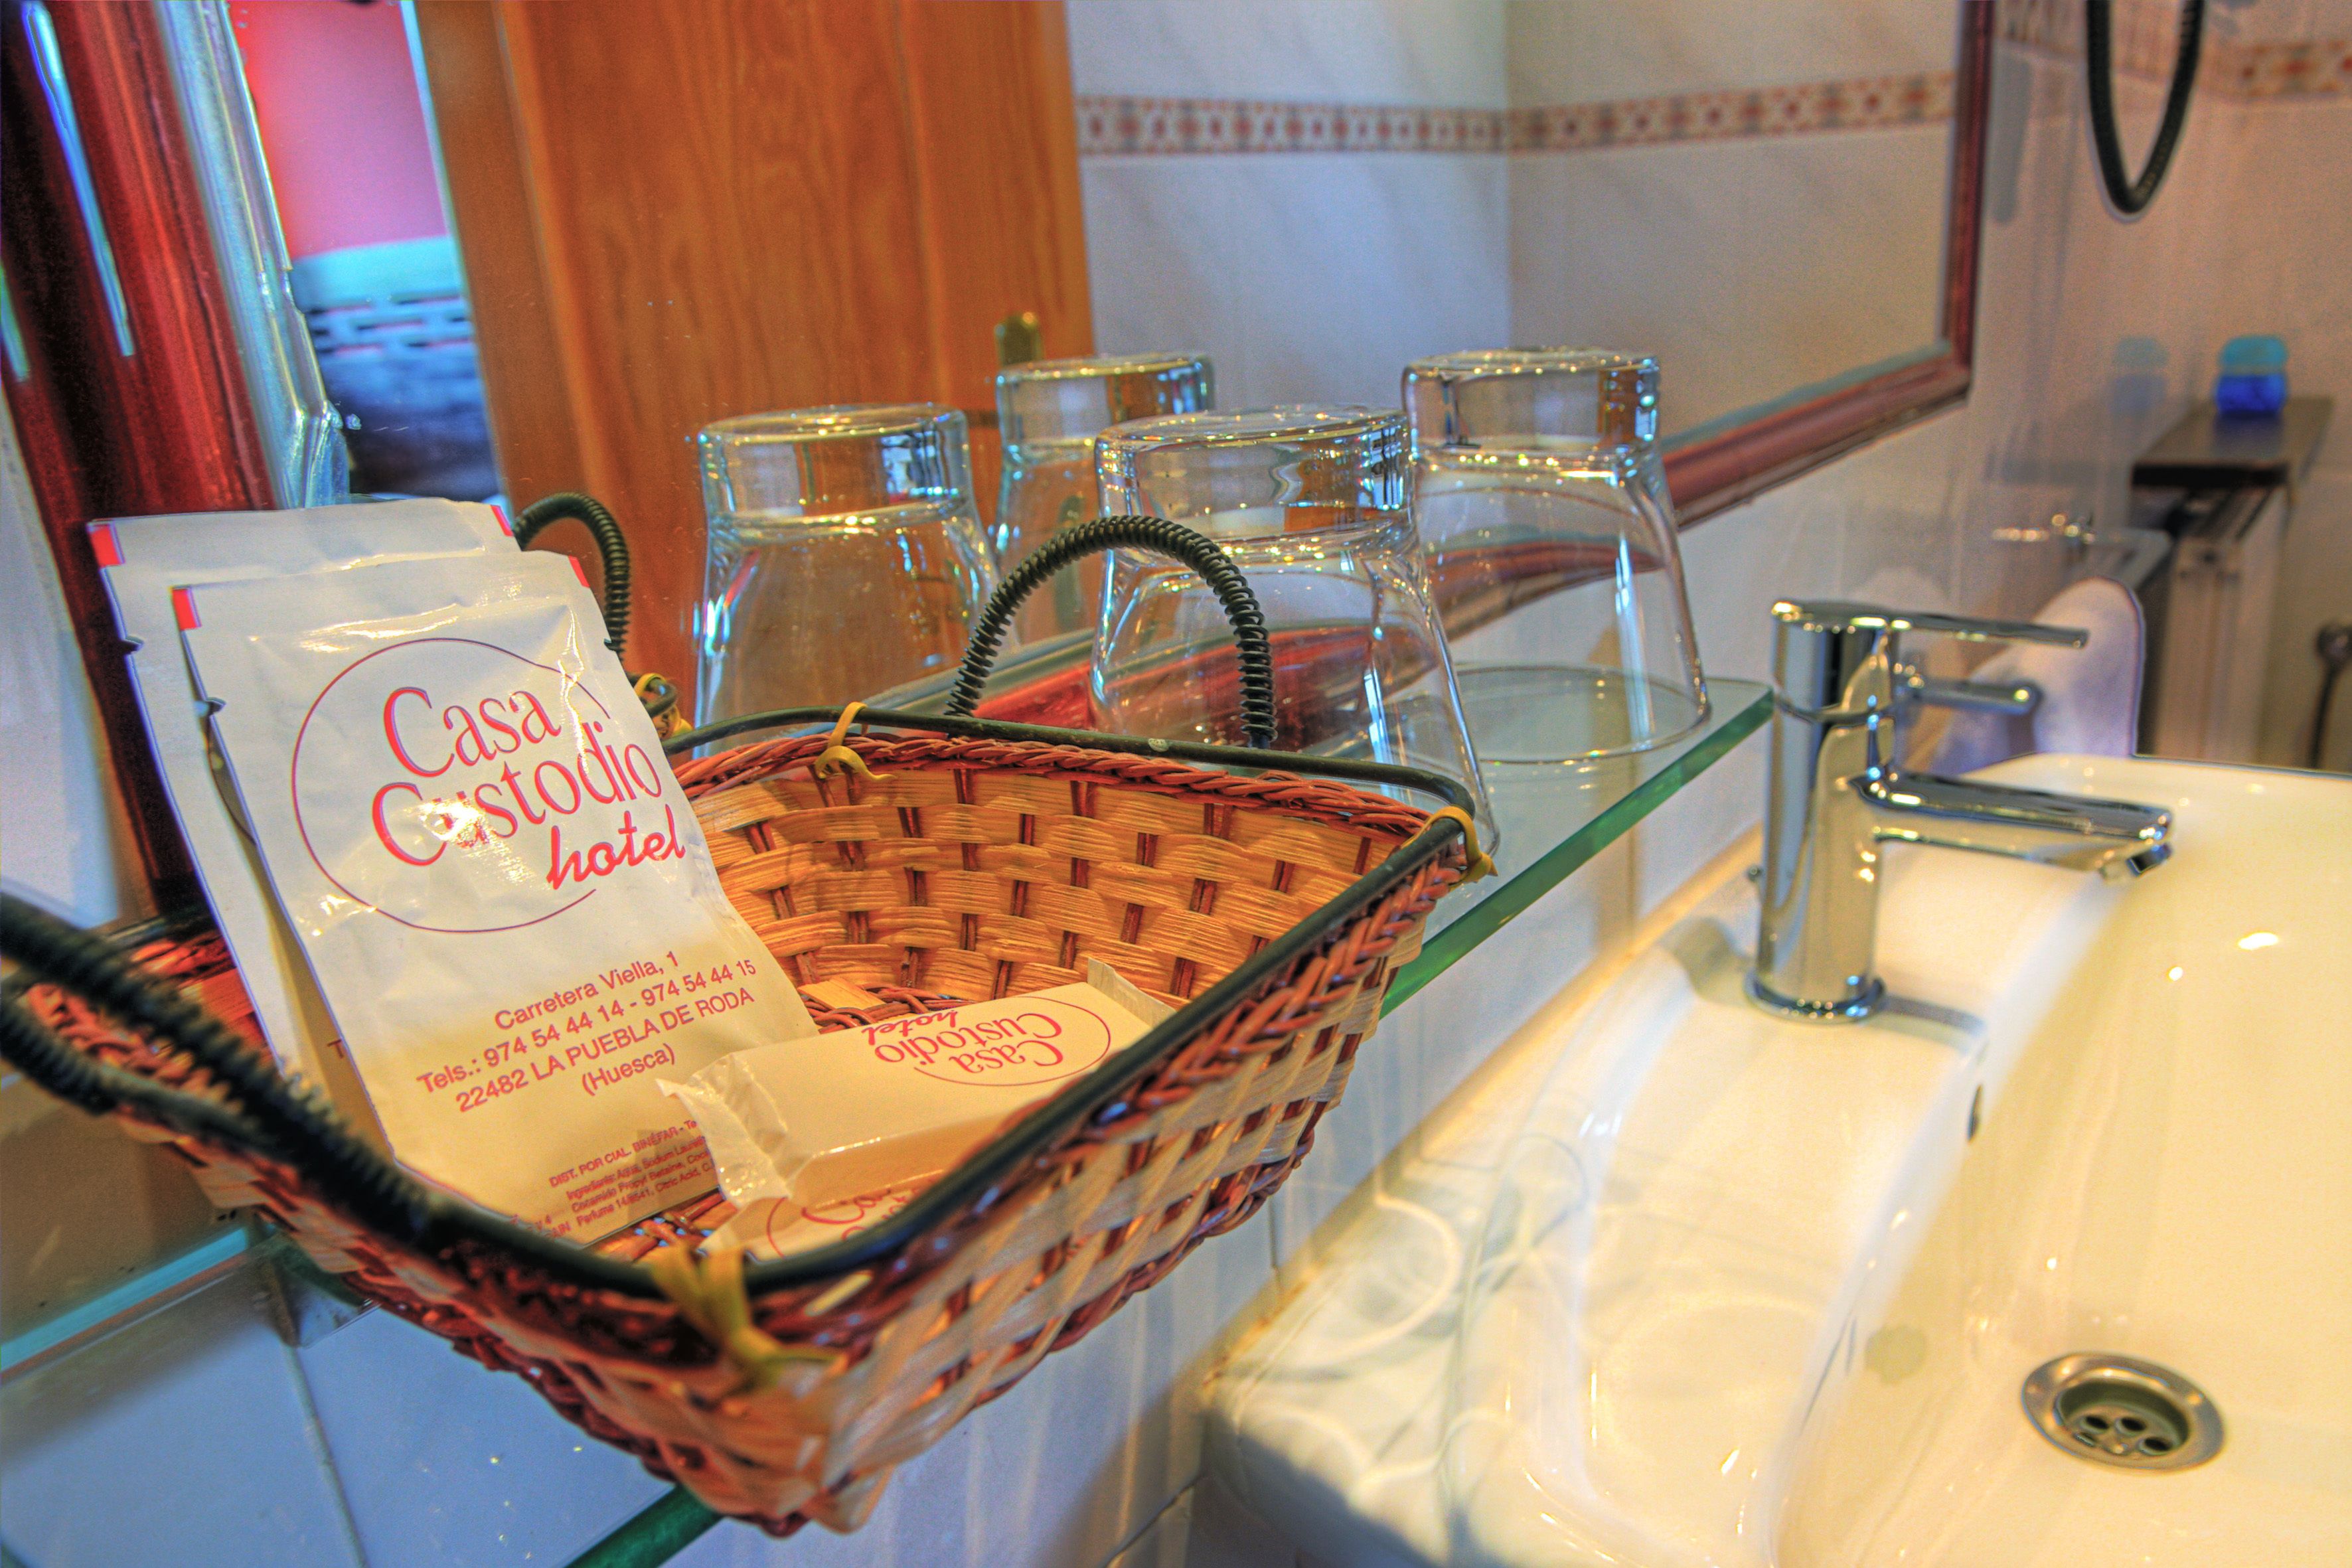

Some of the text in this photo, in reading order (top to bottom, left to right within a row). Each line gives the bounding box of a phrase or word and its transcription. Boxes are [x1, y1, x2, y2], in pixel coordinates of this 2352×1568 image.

[384, 686, 562, 778] Casa
[372, 722, 662, 866] Custodio
[546, 803, 686, 890] hotel
[416, 1058, 481, 1093] Tels.:
[483, 1036, 527, 1067] 974
[531, 1024, 560, 1048] 54
[566, 1011, 593, 1034] 44
[597, 999, 624, 1022] 14
[641, 979, 680, 1006] 974
[682, 971, 706, 992] 54
[710, 964, 733, 984] 44
[736, 959, 756, 976] 15
[495, 951, 678, 1030] Carretera Viella, 1
[861, 1010, 959, 1046] hotel
[455, 987, 755, 1113] 22482 LA PUEBLA DE RODA
[582, 1043, 674, 1096] (Huesca)
[874, 1012, 1062, 1065] Custodio
[949, 1040, 1063, 1073] Casa
[549, 1168, 578, 1188] DIST.
[579, 1158, 603, 1175] POR
[605, 1148, 631, 1164] CIAL.
[684, 1119, 698, 1129] Te
